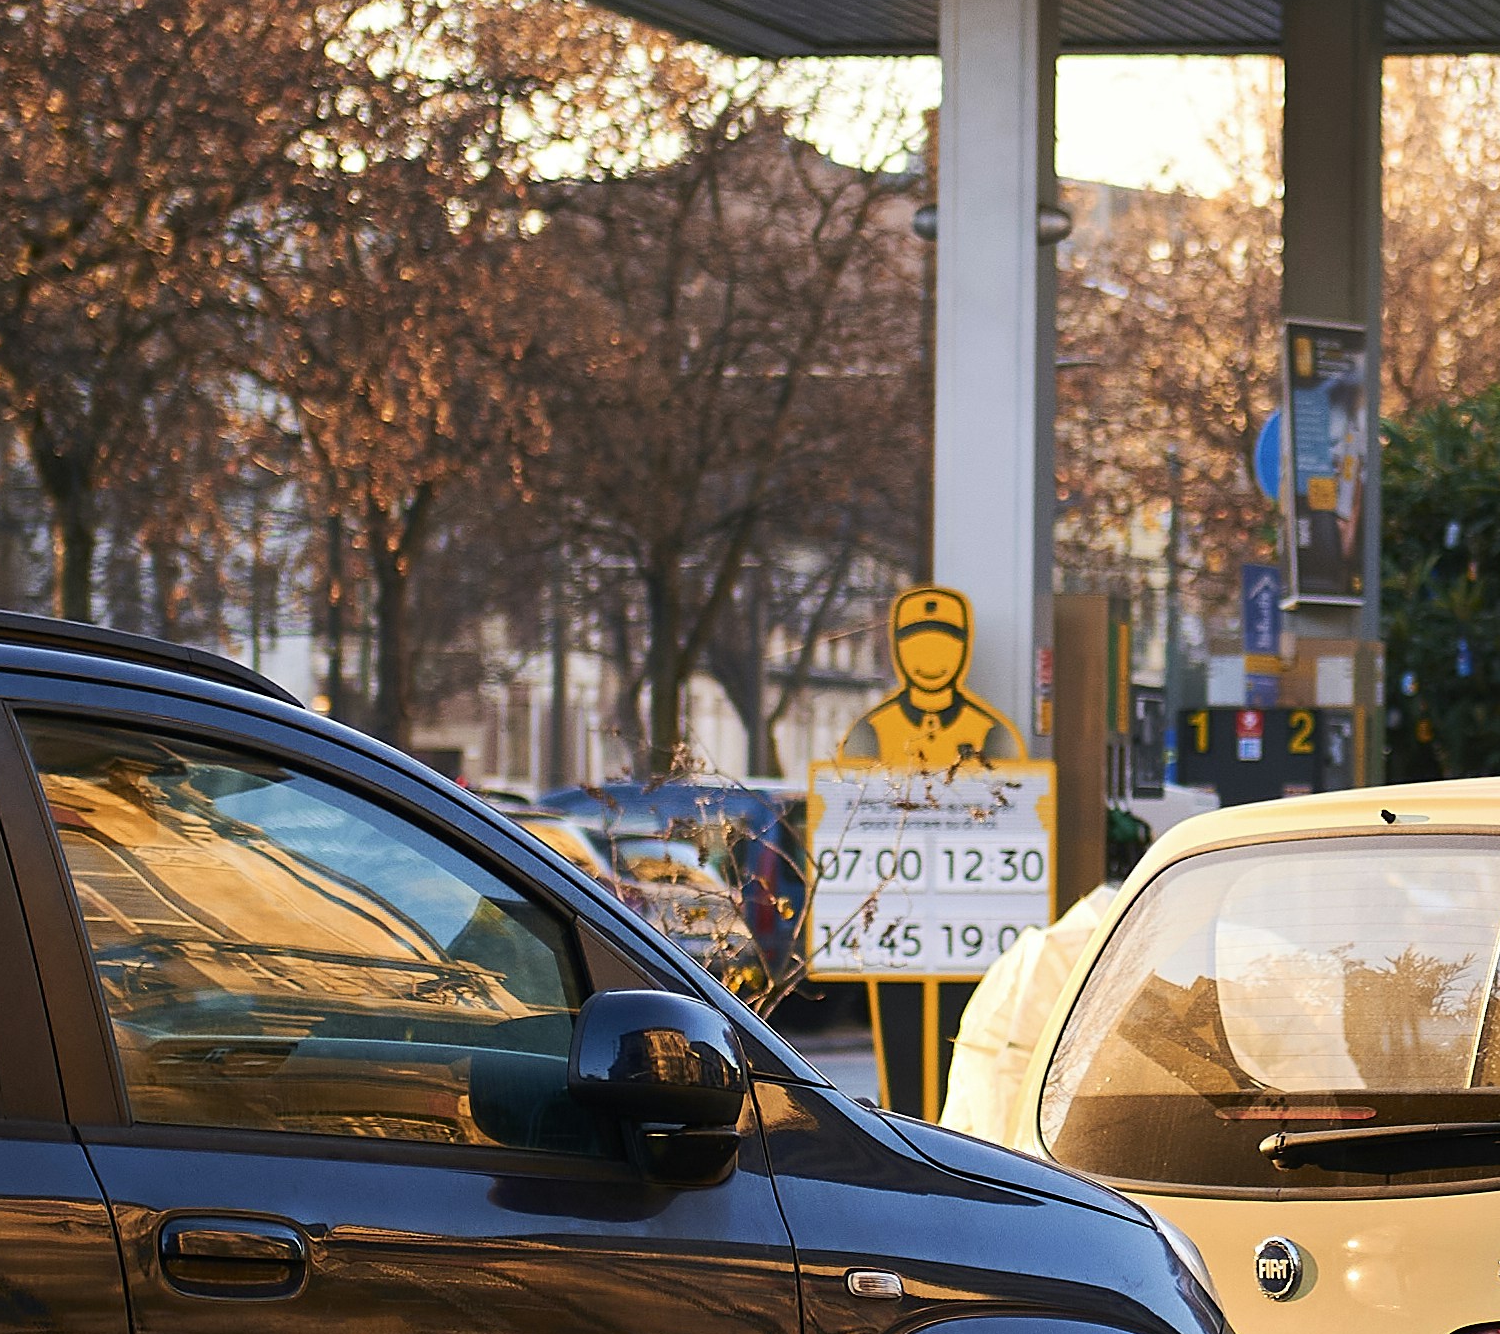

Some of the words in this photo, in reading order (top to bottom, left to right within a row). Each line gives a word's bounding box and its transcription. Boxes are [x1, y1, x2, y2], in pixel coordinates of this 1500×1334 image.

[1188, 710, 1209, 754] 1
[1288, 710, 1315, 755] 2
[941, 923, 1042, 957] 19:0
[1258, 1258, 1289, 1279] FIAT
